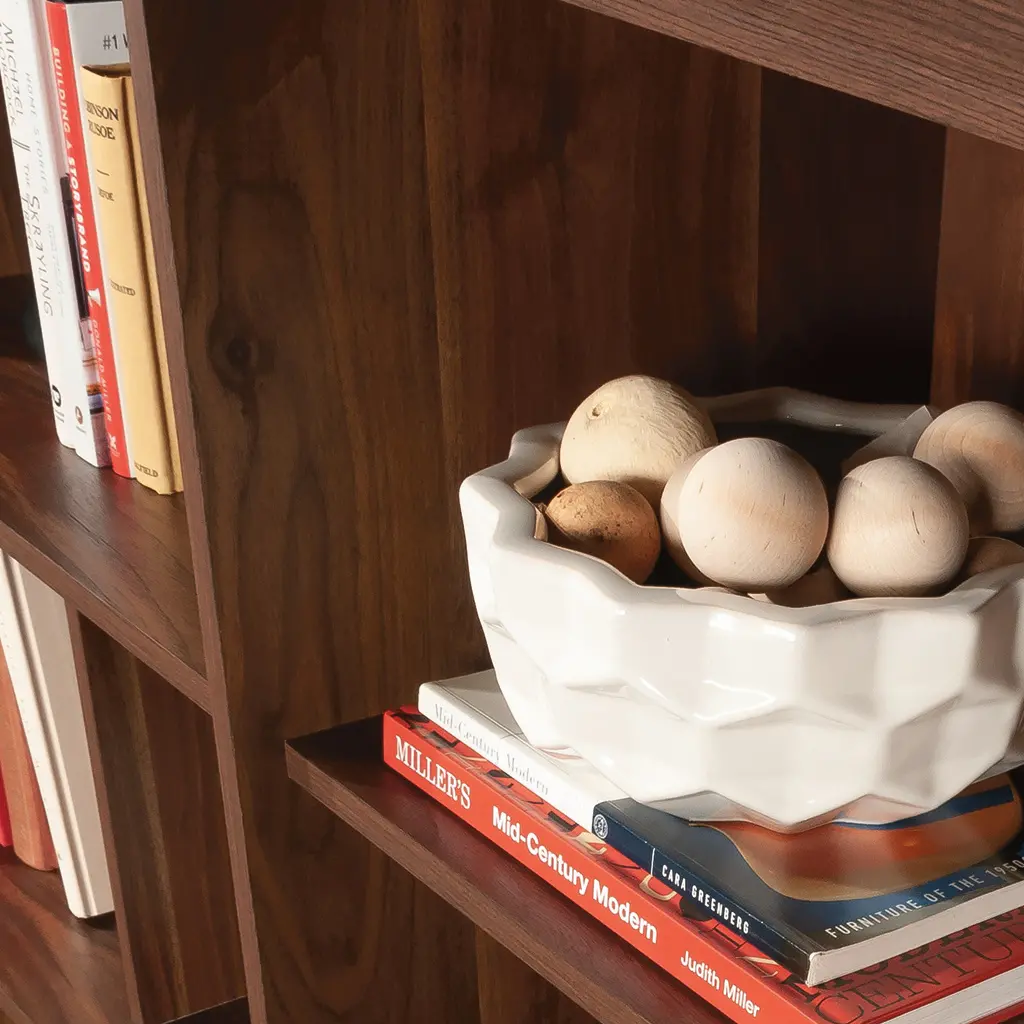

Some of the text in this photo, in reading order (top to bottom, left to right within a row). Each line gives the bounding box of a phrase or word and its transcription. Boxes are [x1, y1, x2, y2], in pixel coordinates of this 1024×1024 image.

[52, 47, 70, 133] BUILDING
[67, 158, 91, 274] STORYBRAND
[434, 703, 549, 796] Mid-Century Modern
[395, 735, 471, 810] MILLER'S
[492, 805, 589, 896] Mid-Century
[593, 878, 658, 944] Modern
[680, 951, 721, 991] Judith
[723, 979, 760, 1018] Miller
[662, 864, 750, 935] CARA GREENBERG
[825, 898, 923, 939] FURNITURE
[923, 888, 945, 903] OF
[948, 874, 985, 893] THE
